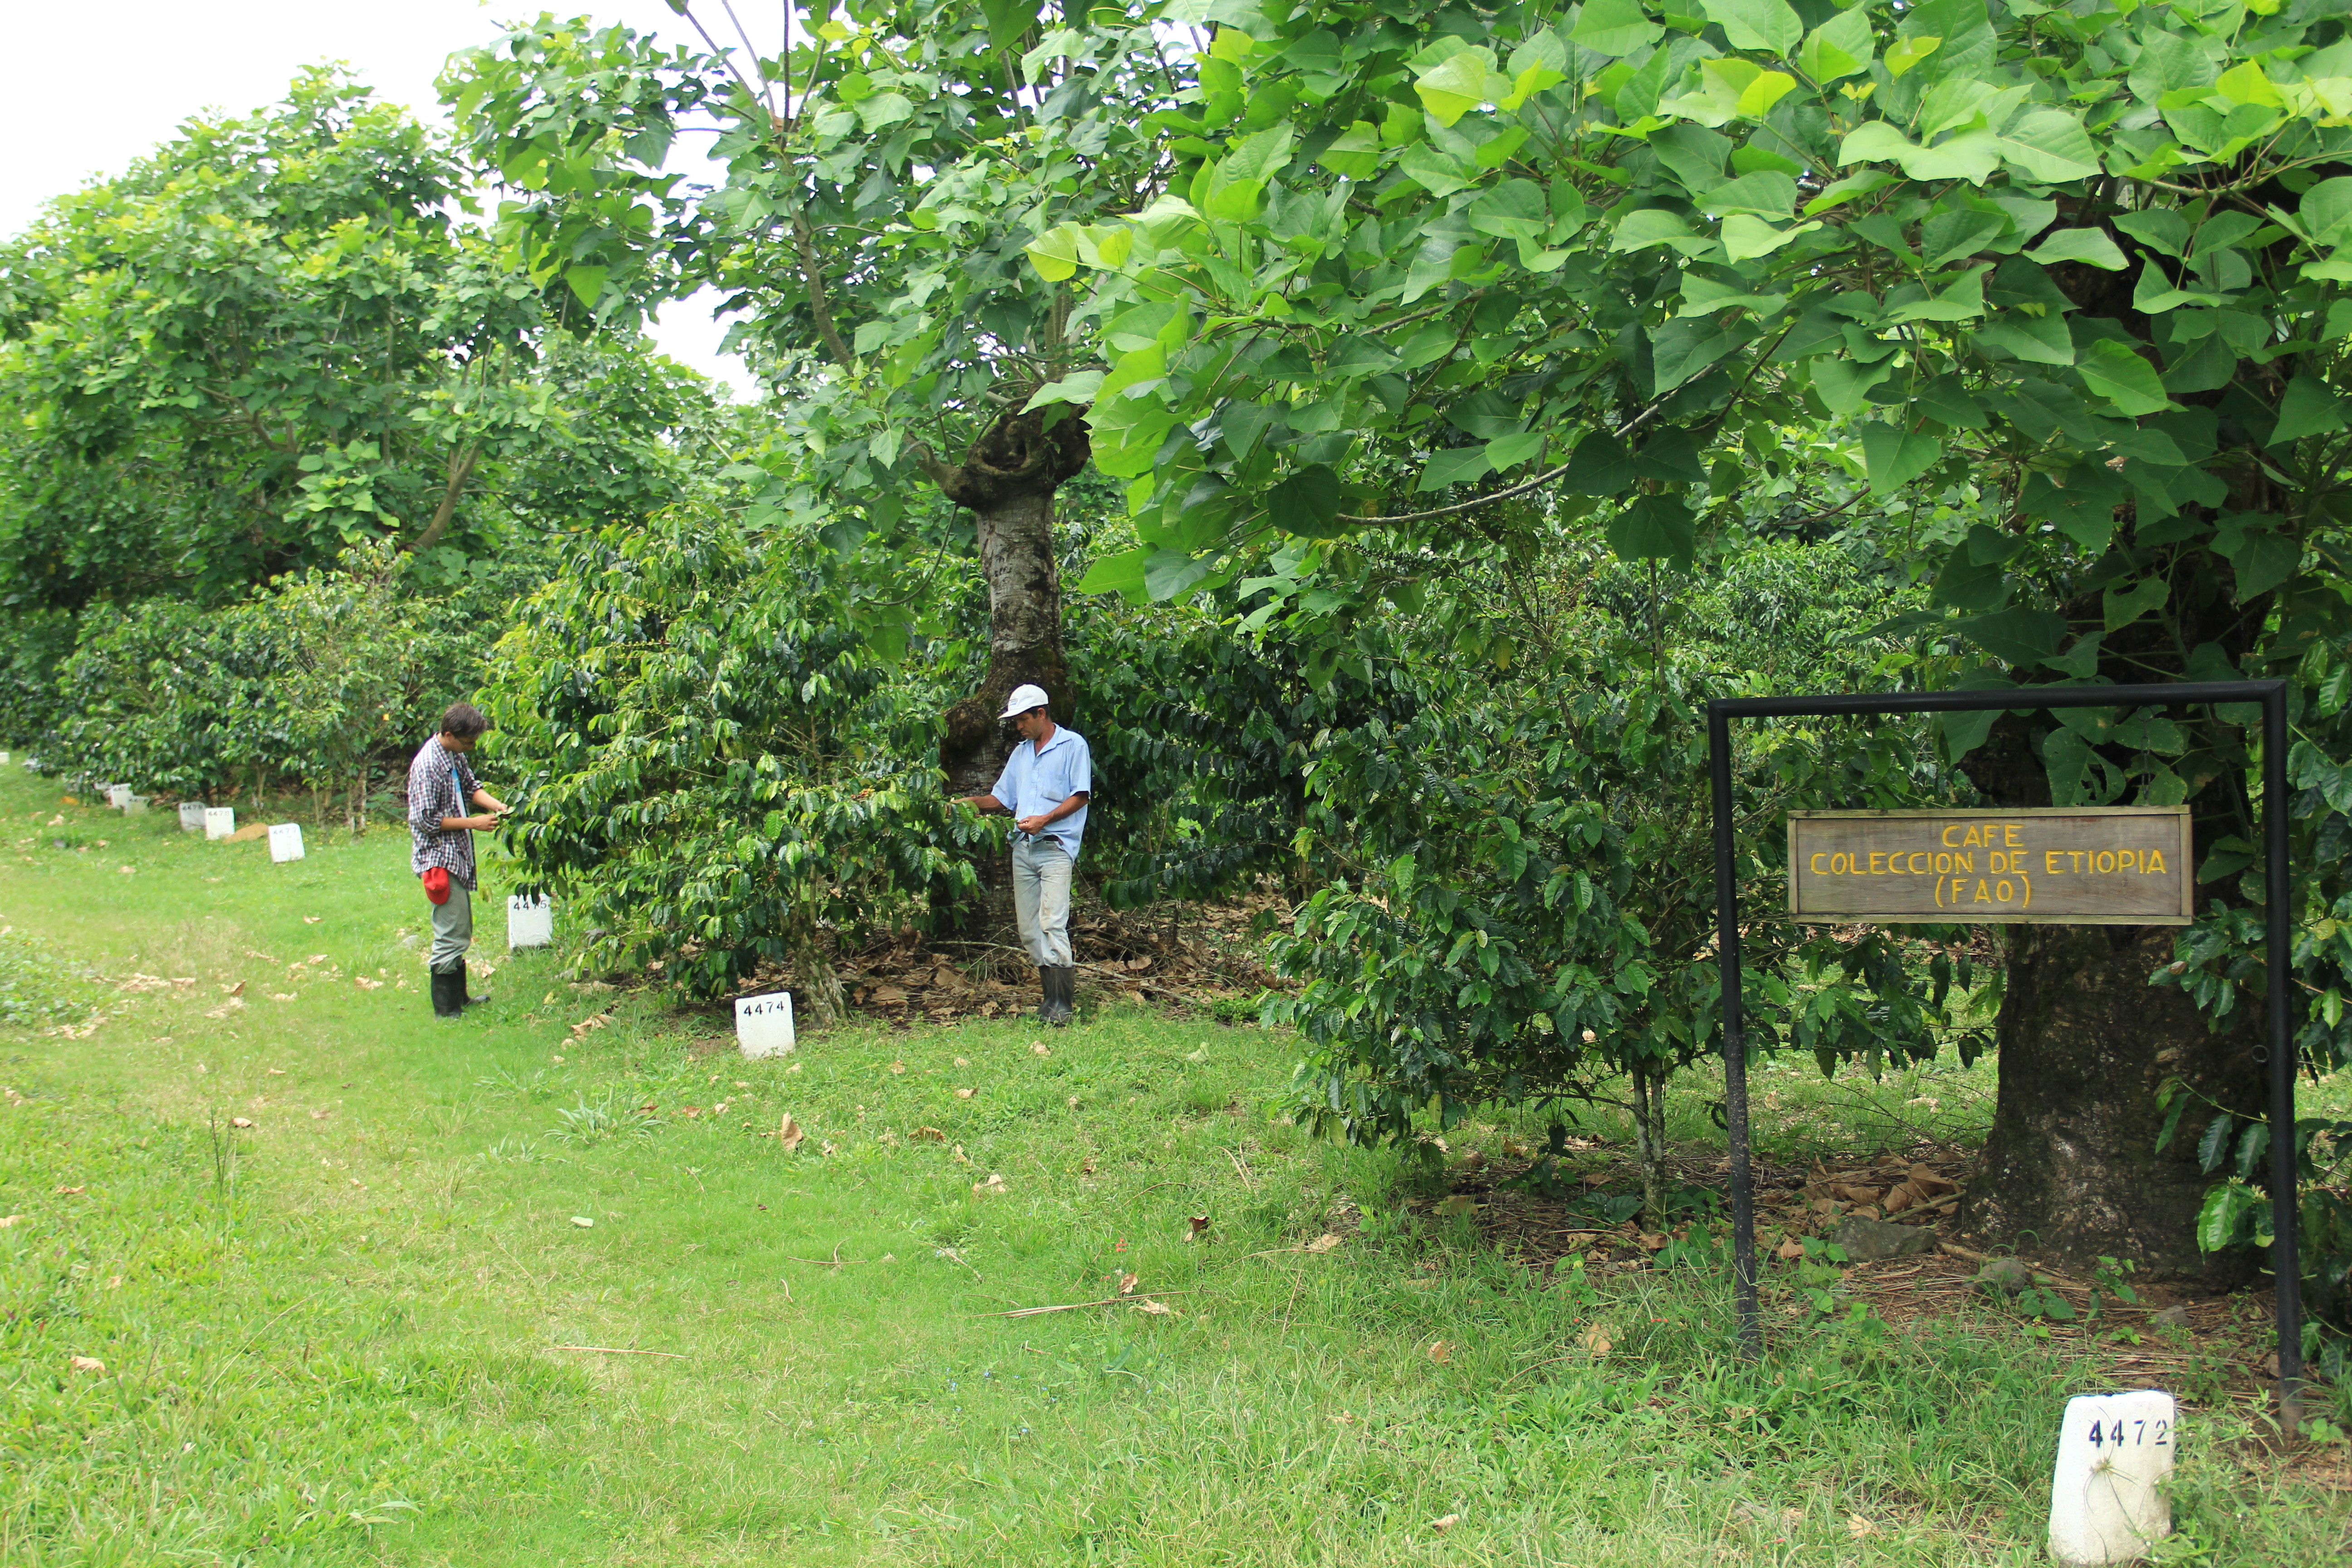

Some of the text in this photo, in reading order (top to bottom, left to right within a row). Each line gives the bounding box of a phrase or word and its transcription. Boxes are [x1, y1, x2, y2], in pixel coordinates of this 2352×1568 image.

[1941, 824, 2024, 848] CAFE
[1810, 849, 2166, 875] COLECCION DE ETIOPIA
[1935, 876, 2032, 908] (FAO)
[744, 1001, 784, 1016] 4474
[2089, 1419, 2167, 1448] 4472
